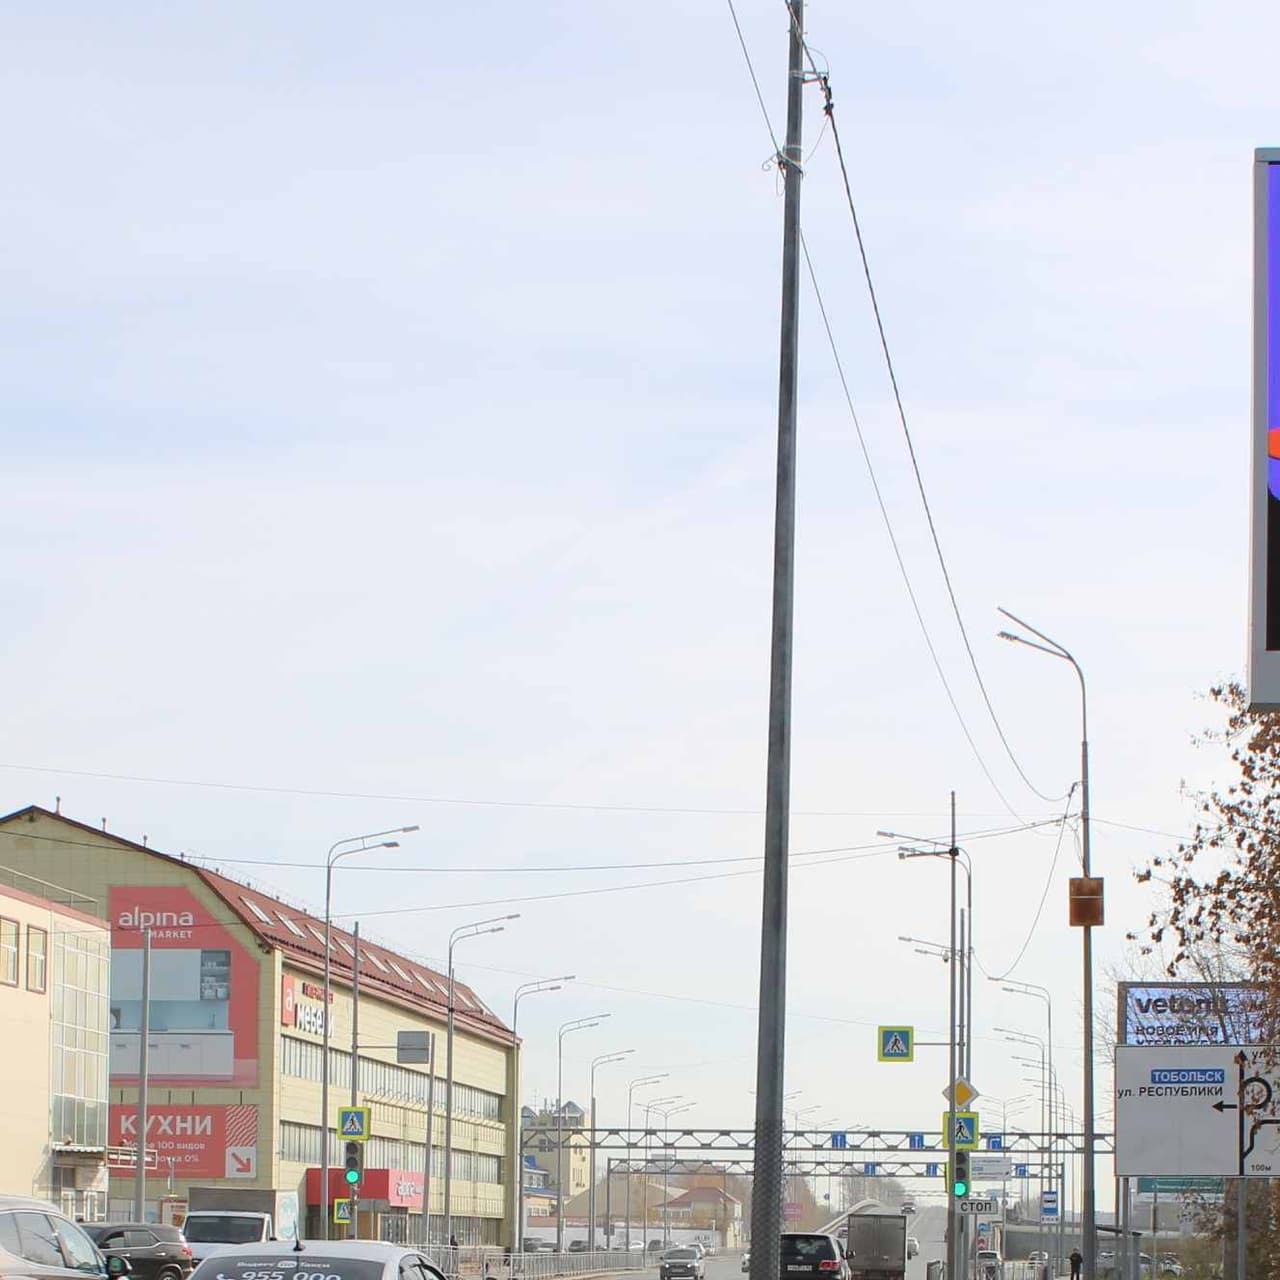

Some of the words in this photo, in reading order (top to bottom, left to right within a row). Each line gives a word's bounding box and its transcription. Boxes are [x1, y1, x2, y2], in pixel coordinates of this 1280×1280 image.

[119, 905, 194, 933] alpina
[149, 930, 193, 939] MARKET
[298, 1002, 334, 1038] мебеи
[1152, 1071, 1223, 1083] ТОБОЛЬСК
[1117, 1088, 1135, 1098] ул.
[1138, 1086, 1224, 1097] РЕСПУБЛИКИ
[120, 1115, 212, 1136] КУХНИ
[1251, 1164, 1271, 1172] 100м
[960, 1202, 992, 1212] СТОП
